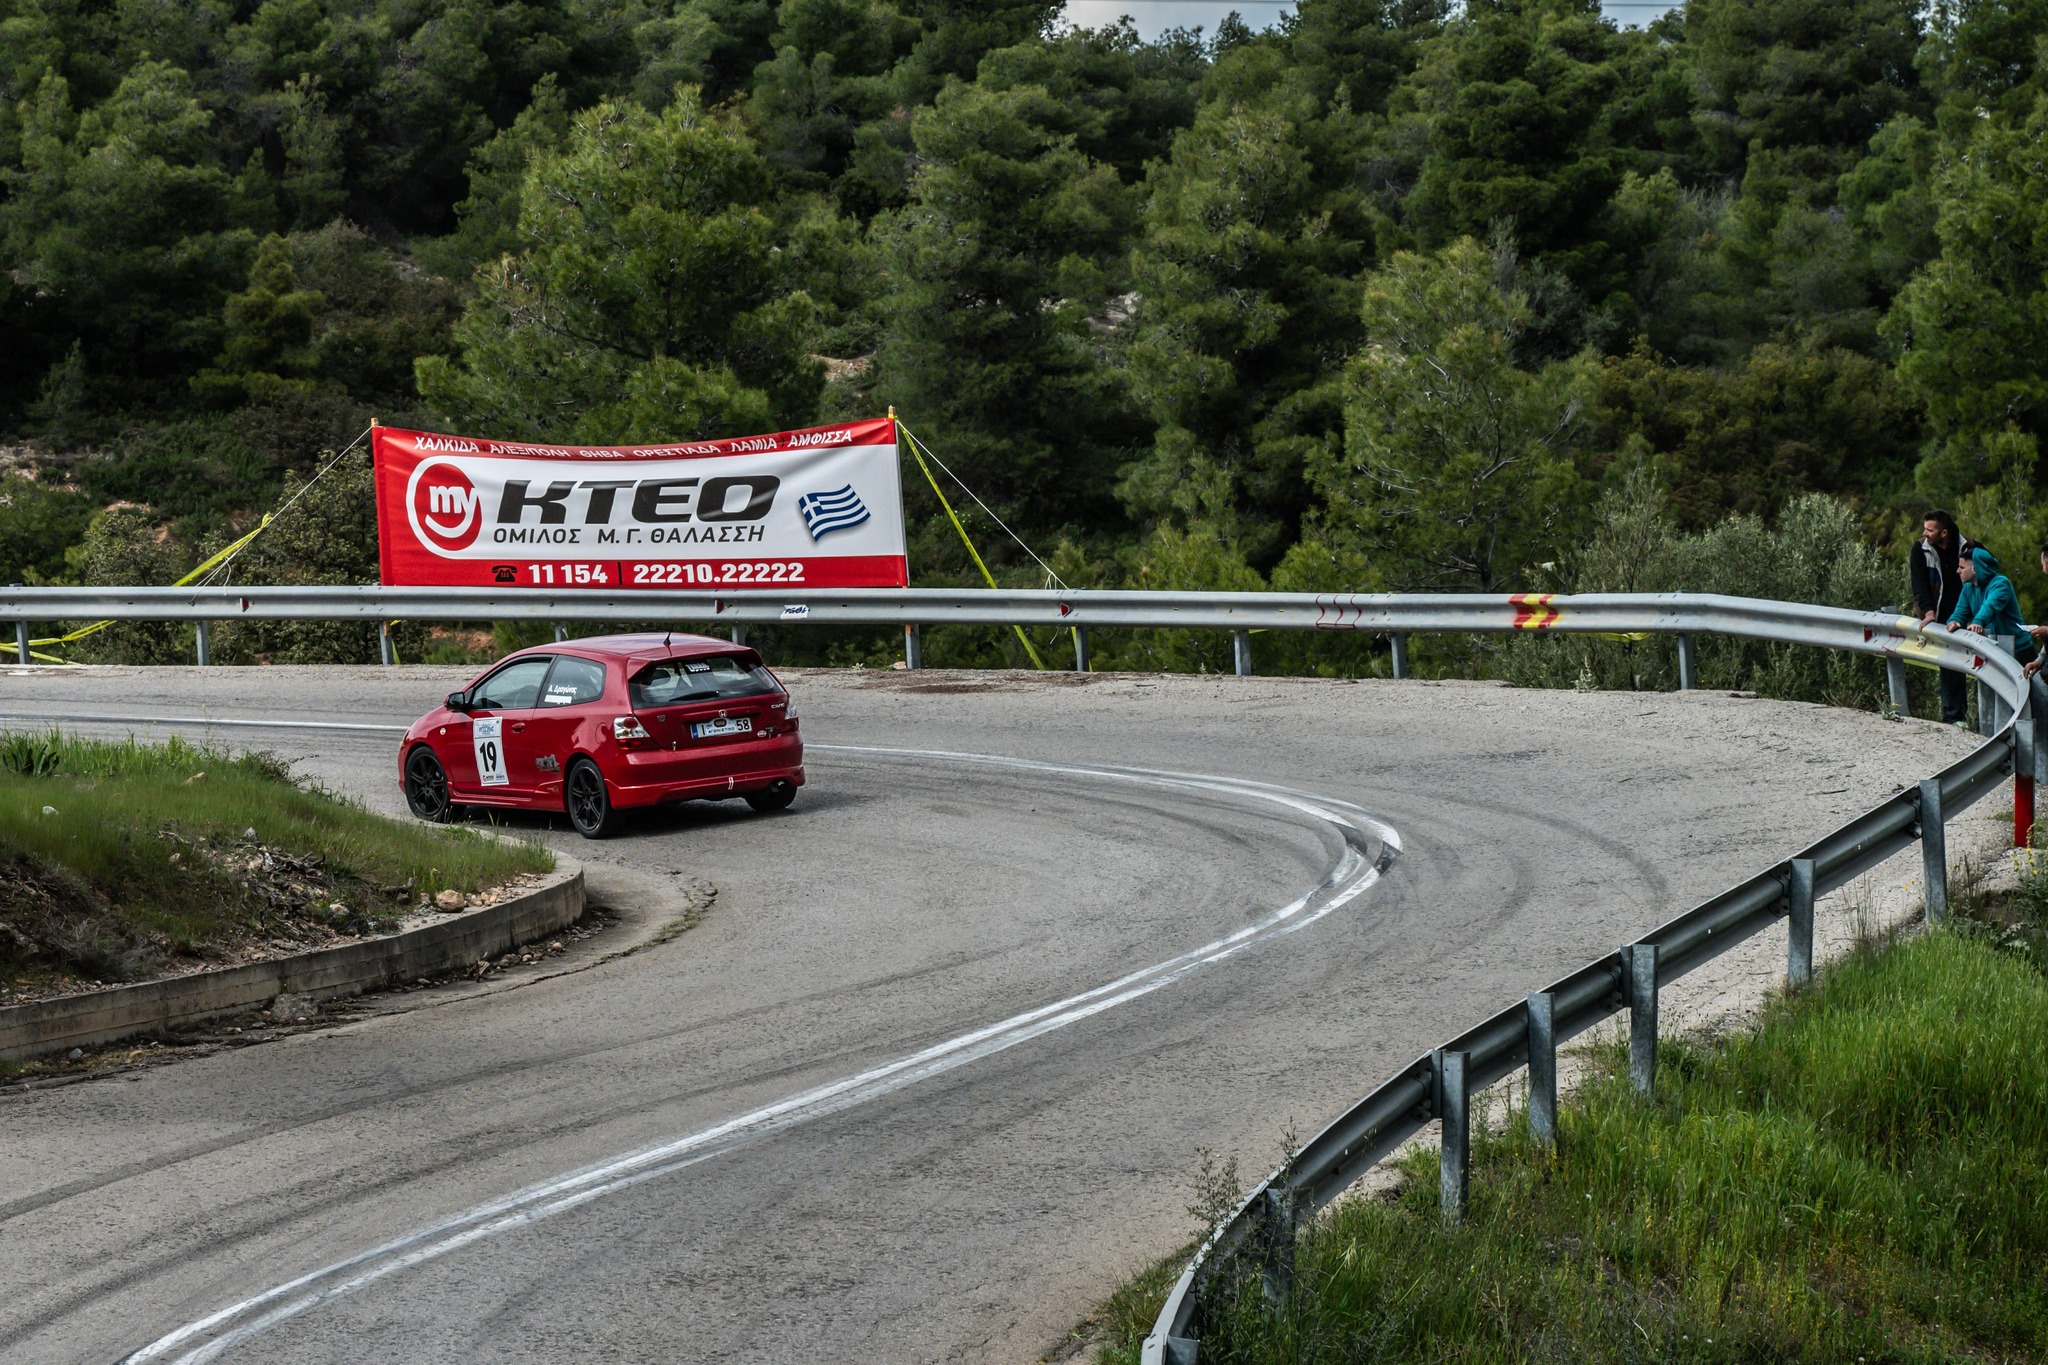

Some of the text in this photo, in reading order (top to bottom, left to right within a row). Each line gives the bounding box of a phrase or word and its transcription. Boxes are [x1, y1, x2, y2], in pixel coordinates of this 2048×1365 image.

[414, 436, 479, 453] ΧΑΛΚΙΔΑ
[579, 450, 625, 458] ΘΗΒΑ
[633, 444, 721, 457] ΟΡΕΣΤΙΑΔΑ
[731, 438, 778, 453] ΛΑΜΙΑ
[787, 430, 852, 448] ΑΜΦΙΣΣΑ
[426, 485, 478, 531] my
[497, 475, 780, 525] ΚΤΕΟ
[493, 528, 581, 544] ΟΜΙΛΟΣ
[650, 525, 765, 543] ΘΑΛΑΣΣΗ
[633, 562, 805, 584] 22210.22222
[736, 719, 750, 731] 58
[479, 741, 497, 772] 19
